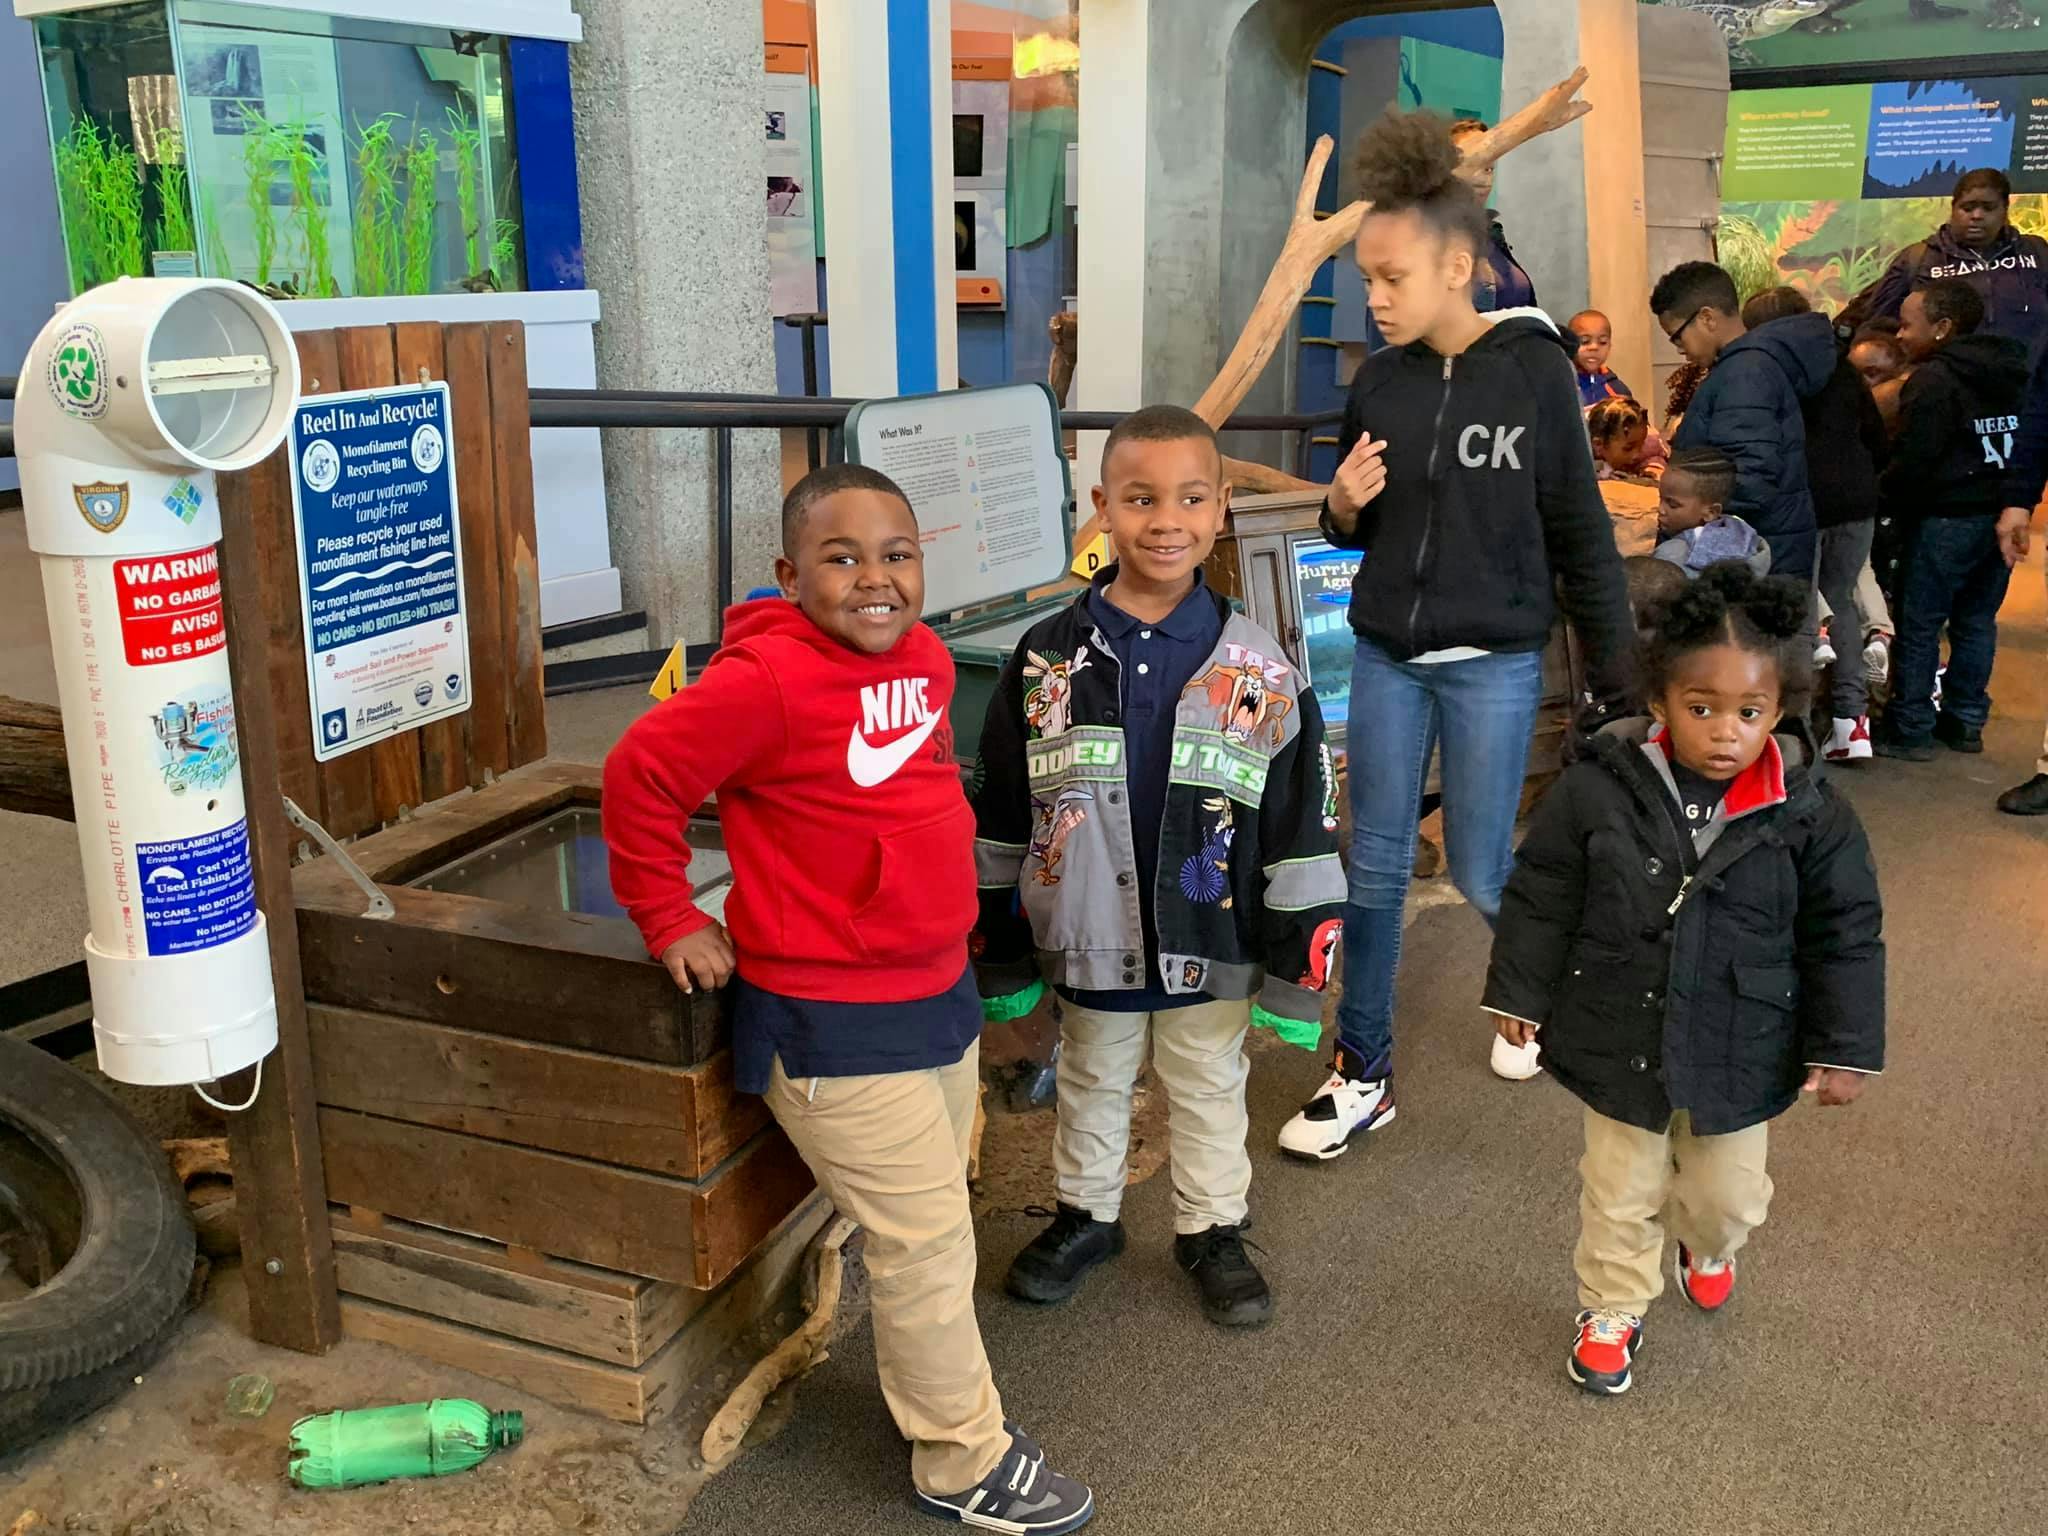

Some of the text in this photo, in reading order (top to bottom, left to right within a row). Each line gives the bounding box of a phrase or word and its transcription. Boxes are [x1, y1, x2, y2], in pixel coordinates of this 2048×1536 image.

[302, 398, 438, 435] Reel In And Recycle!
[879, 428, 898, 440] What
[342, 438, 408, 458] Monofilament
[1458, 424, 1526, 470] CK
[347, 457, 407, 479] Recycling Bin
[81, 486, 120, 494] VIRGINIA
[331, 478, 428, 512] Keep our waterways
[356, 501, 408, 524] tangle-free
[318, 514, 443, 554] Please recycle your used
[312, 530, 450, 575] monofilament fishing line here!
[1087, 552, 1099, 571] D
[133, 579, 221, 611] NO GARBAG
[312, 567, 455, 612] For more information on monofilament
[1322, 577, 1352, 591] Agn
[171, 610, 218, 635] AVISO
[313, 608, 346, 627] recycling
[346, 604, 361, 618] visit
[141, 646, 168, 660] NO
[172, 642, 192, 656] ES
[1226, 643, 1290, 687] TAZ
[669, 670, 678, 694] L
[860, 678, 934, 735] NIKE
[102, 772, 118, 810] PIPE
[138, 834, 220, 855] MONOFILAMENT
[108, 819, 129, 903] CHARLOTTE
[146, 853, 178, 864] Envase
[196, 862, 220, 876] Cast
[222, 852, 242, 868] Your
[156, 882, 188, 894] Used
[190, 870, 231, 890] Fishing
[145, 911, 161, 920] NO
[163, 908, 191, 919] CANS
[198, 902, 213, 912] NO
[214, 892, 244, 908] BOTTLES
[196, 928, 210, 937] No
[212, 918, 236, 933] Hands
[169, 938, 204, 950] Mantenga
